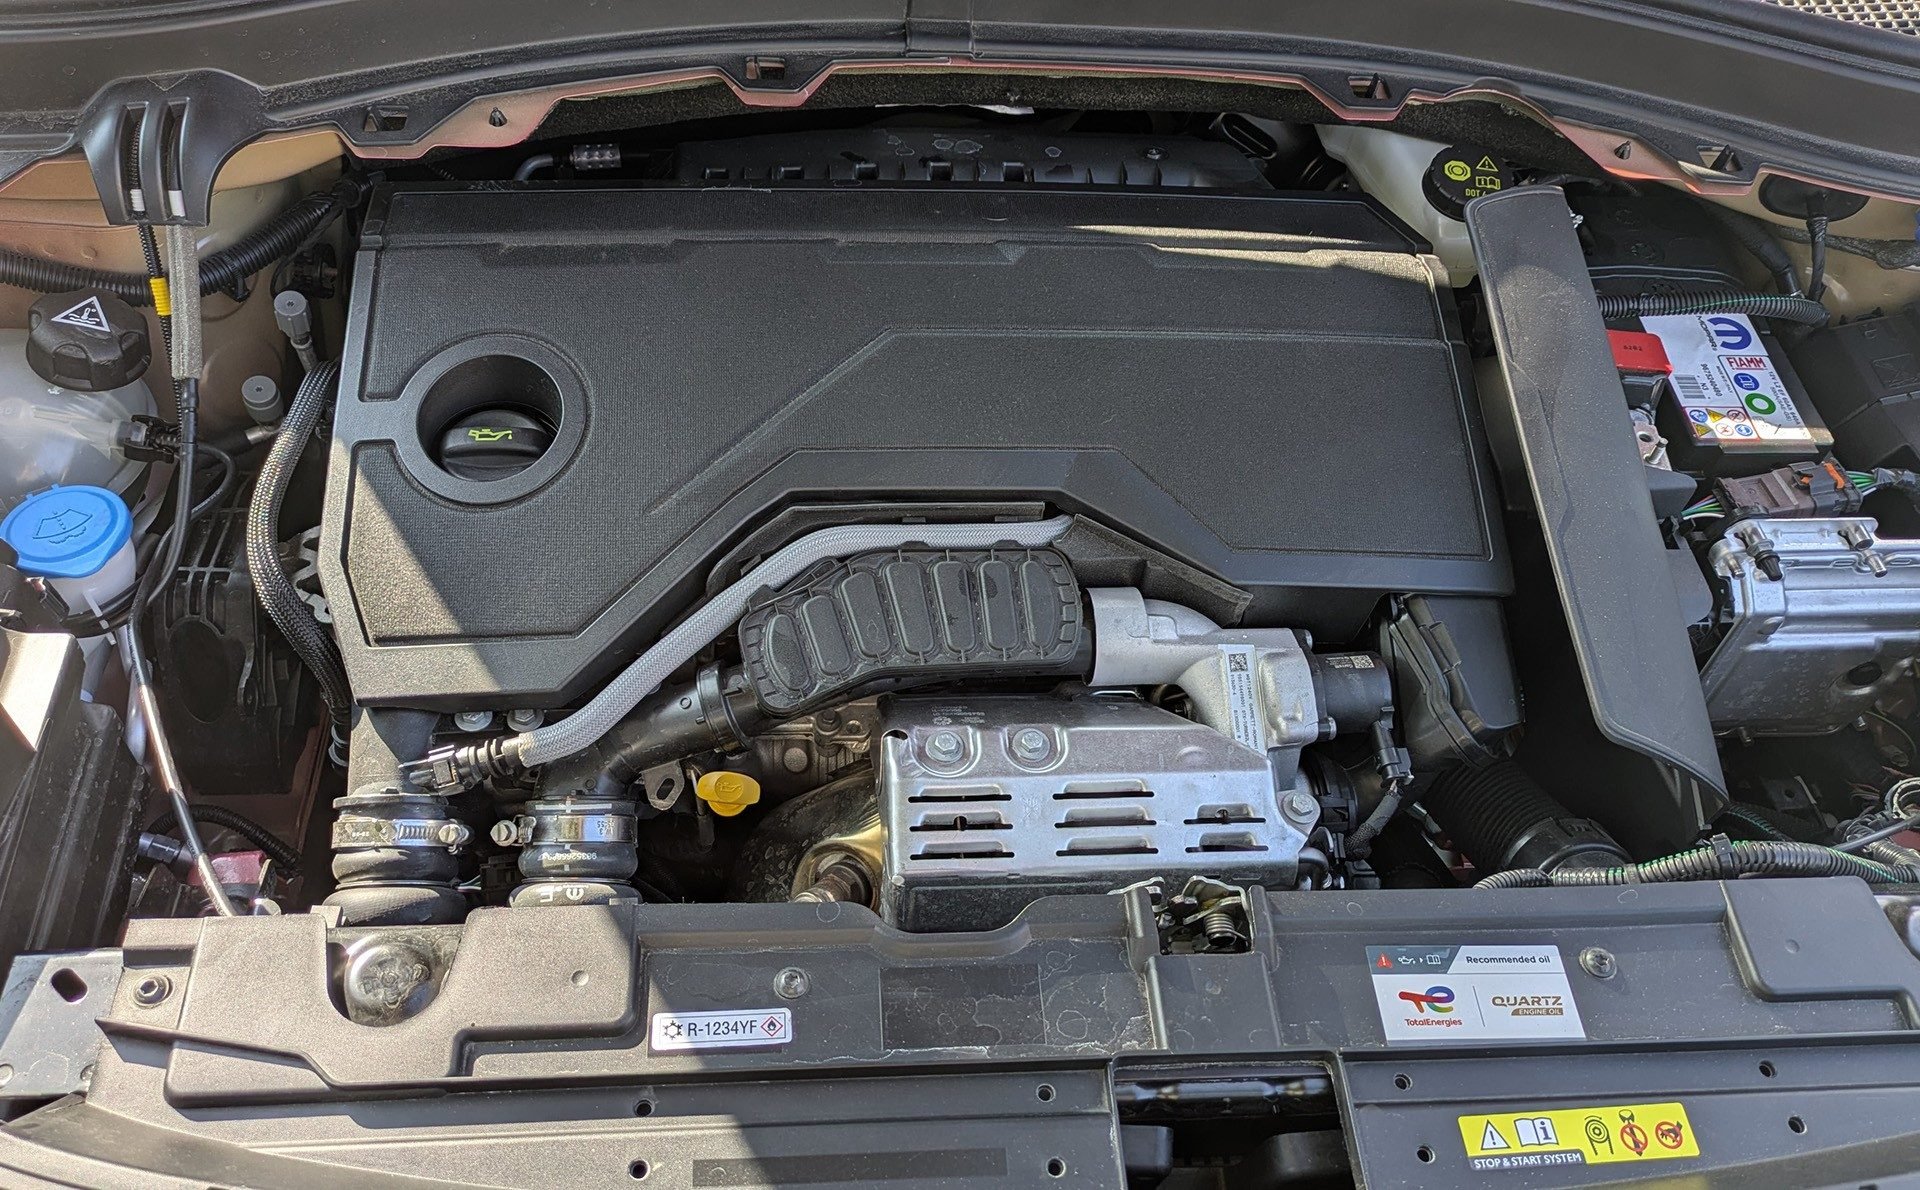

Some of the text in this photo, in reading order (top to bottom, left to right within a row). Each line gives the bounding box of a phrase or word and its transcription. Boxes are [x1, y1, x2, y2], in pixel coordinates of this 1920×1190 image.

[1465, 188, 1480, 197] DOT
[1726, 357, 1766, 368] FIAMM
[1465, 955, 1550, 964] Recommended oil
[1492, 996, 1563, 1007] QUARTZ
[688, 1020, 757, 1036] R-1234YF
[1405, 1018, 1462, 1027] TotalEnergies
[1474, 1152, 1581, 1169] STOP & START SYSTEM
